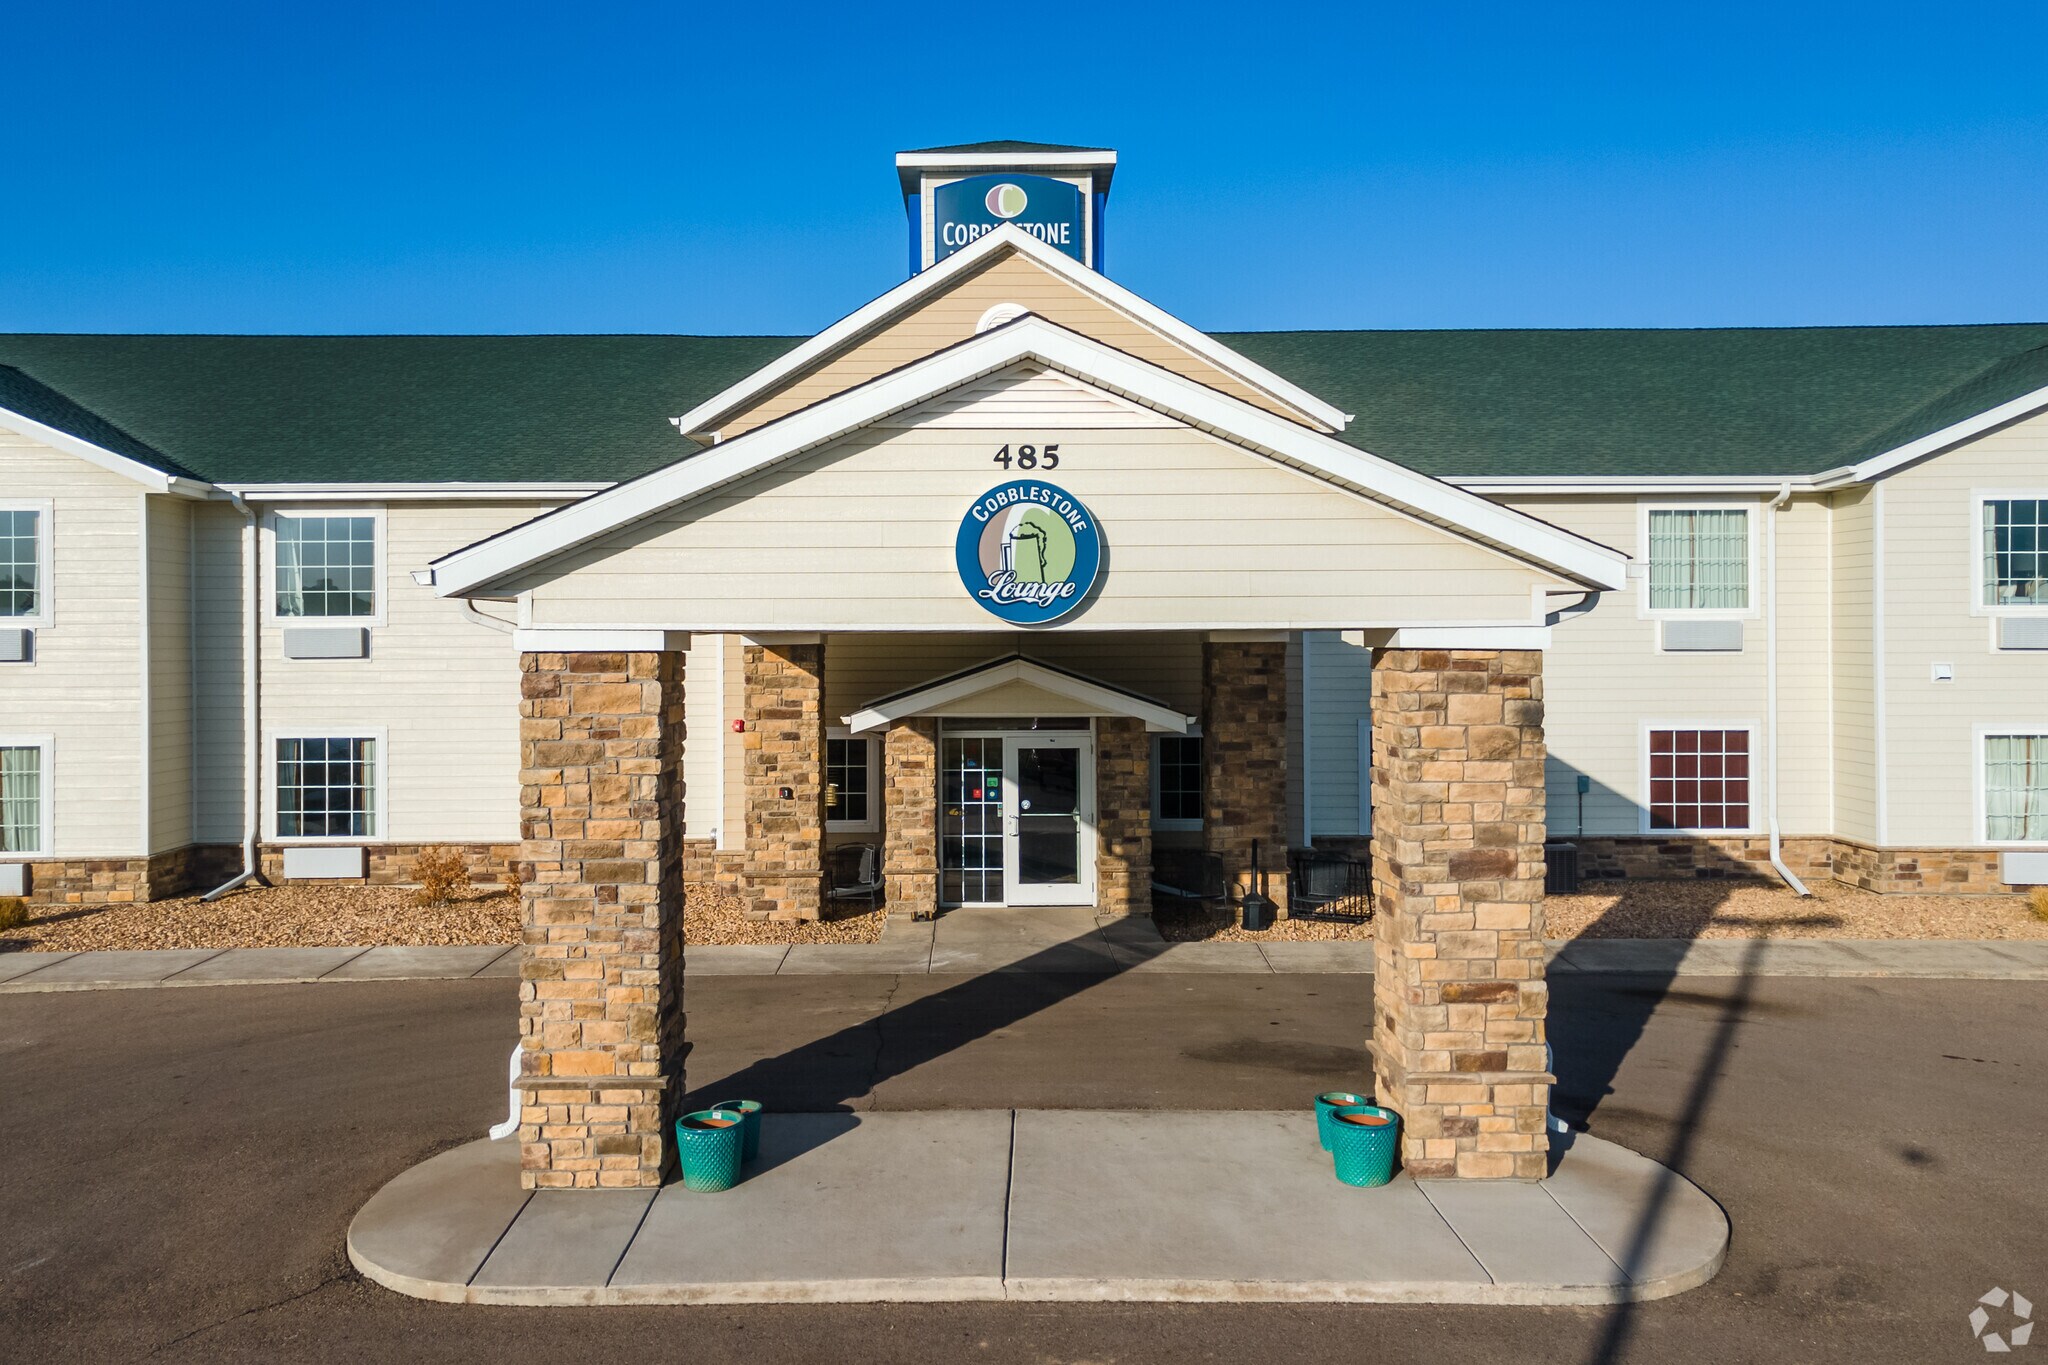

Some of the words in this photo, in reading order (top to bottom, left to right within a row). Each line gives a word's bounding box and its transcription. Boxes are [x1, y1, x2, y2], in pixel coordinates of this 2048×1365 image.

[942, 221, 1071, 246] COBTONE
[993, 443, 1060, 471] 485
[971, 486, 1088, 534] COBBLESTONE
[978, 569, 1076, 608] Lounge
